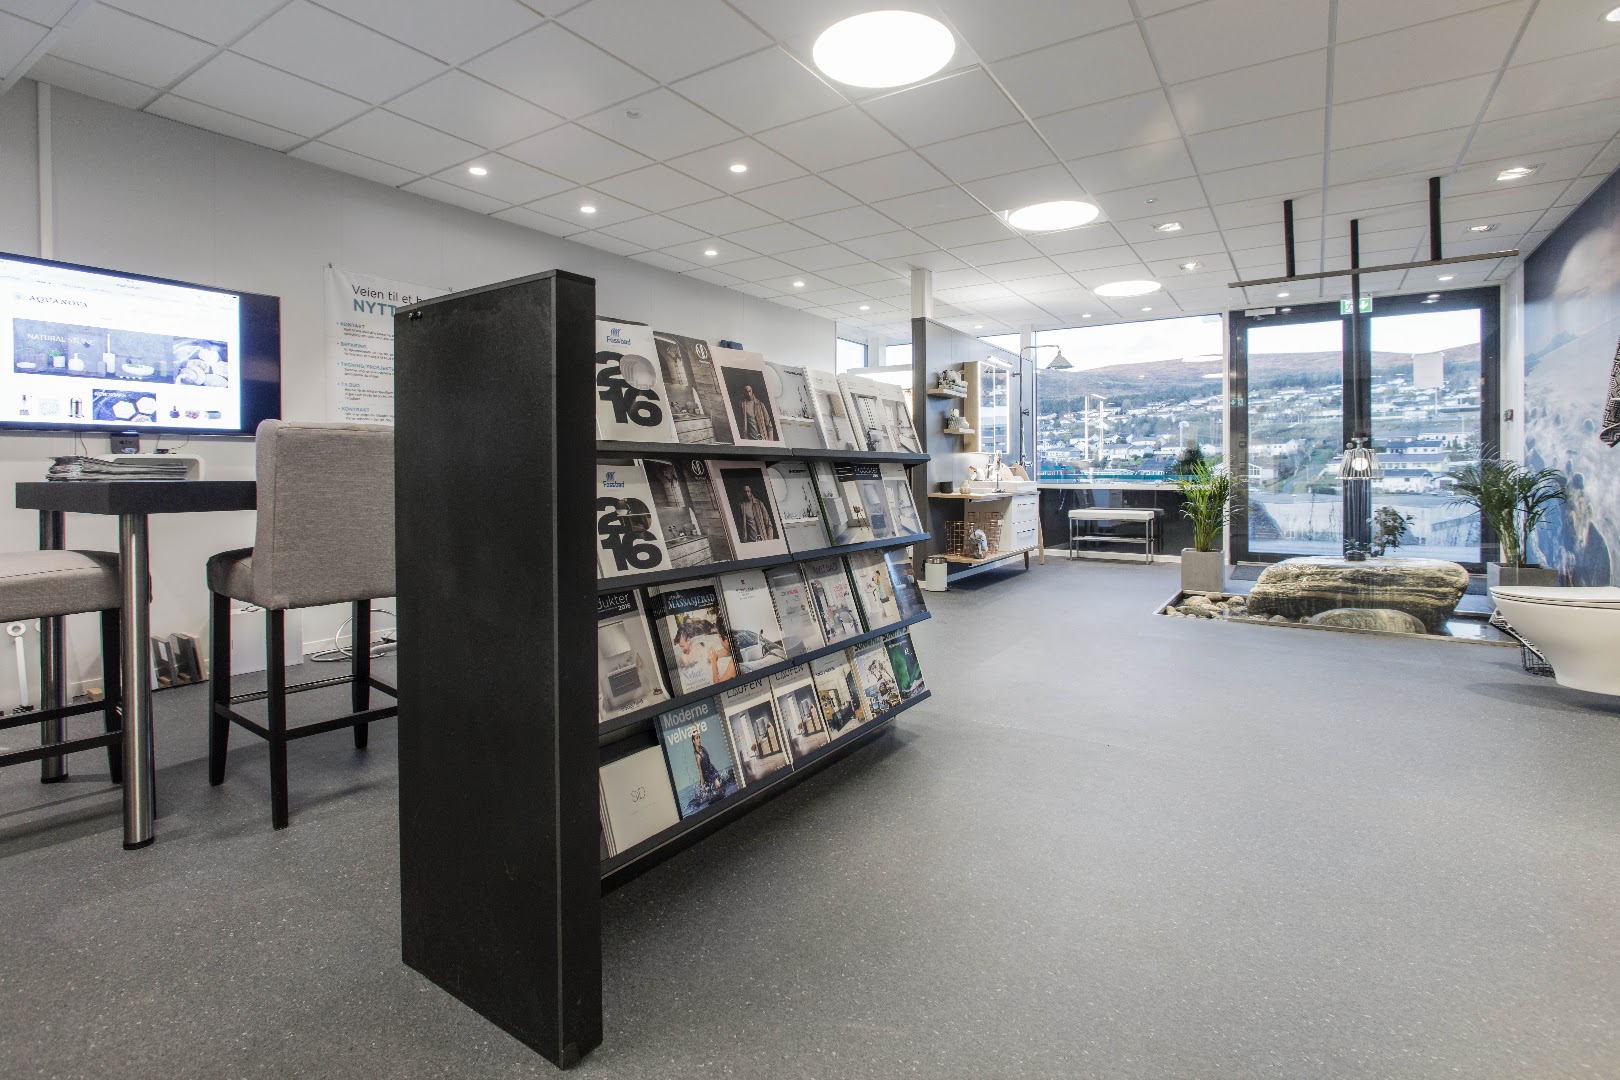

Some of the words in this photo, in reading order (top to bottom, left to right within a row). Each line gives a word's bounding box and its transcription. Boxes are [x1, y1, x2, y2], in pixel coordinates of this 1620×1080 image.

[29, 295, 88, 308] AQUANOVA
[352, 284, 384, 299] Veien
[388, 291, 398, 302] til
[402, 295, 413, 305] et
[353, 298, 397, 318] NYTT
[27, 333, 66, 343] NATURAL
[597, 593, 629, 610] dukter
[618, 603, 632, 612] 2016
[668, 593, 716, 610] MASSASJEBAD
[727, 680, 763, 698] LAUFEN
[663, 702, 709, 728] Moderne
[667, 720, 708, 746] velvære
